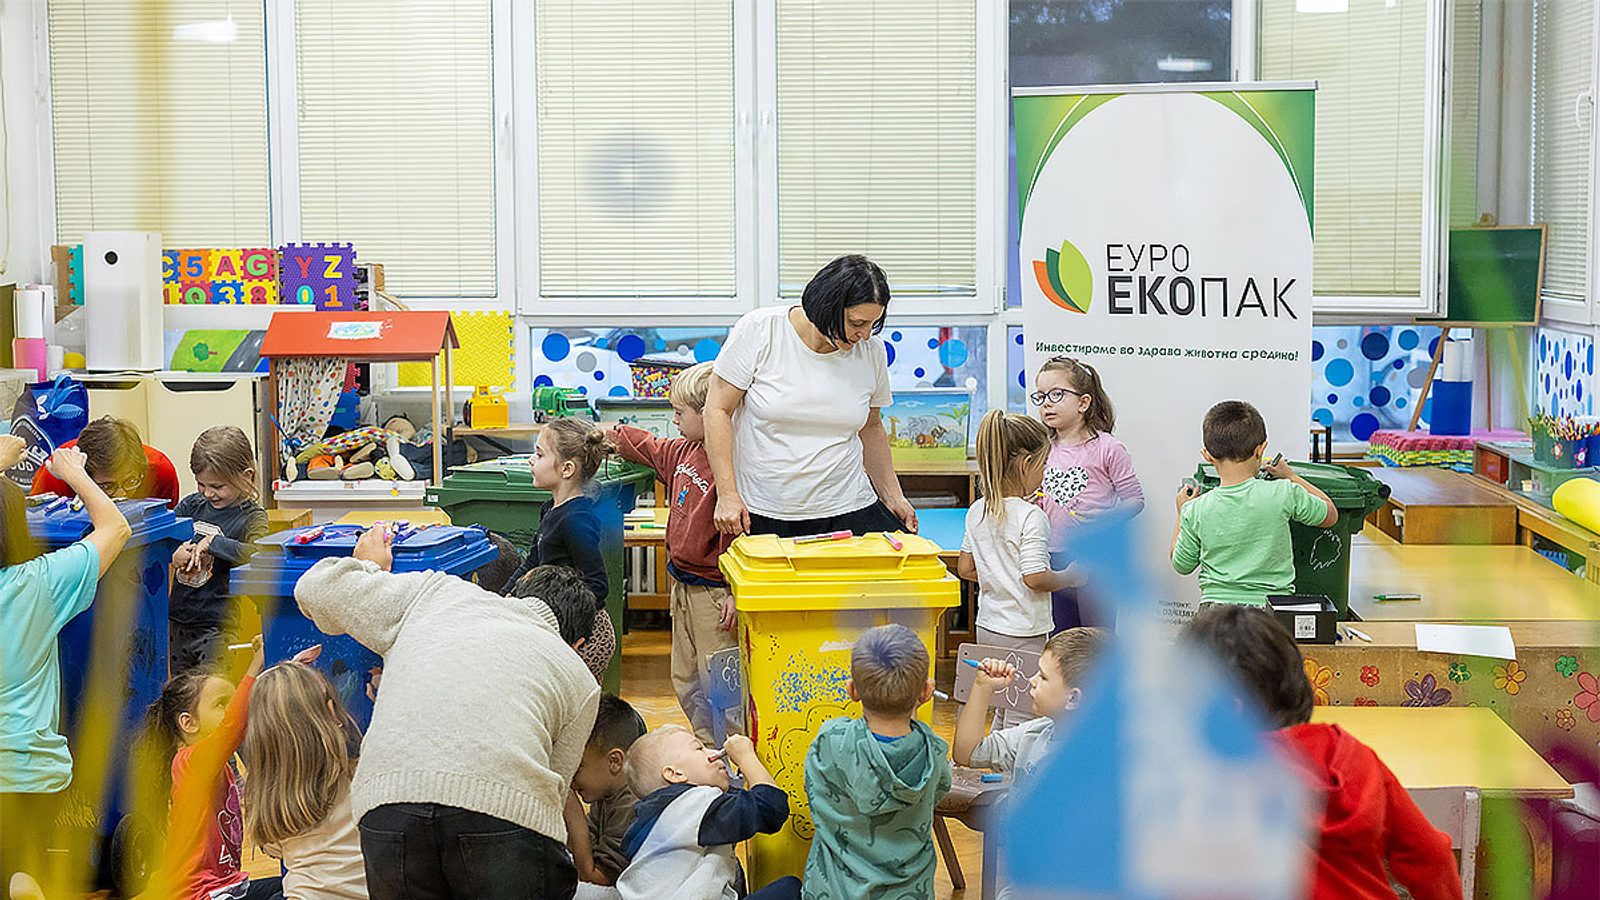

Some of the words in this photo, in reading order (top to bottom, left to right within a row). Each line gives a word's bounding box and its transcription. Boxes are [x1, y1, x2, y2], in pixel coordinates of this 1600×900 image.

[1106, 244, 1190, 272] ЕУРО
[1108, 275, 1298, 319] ЕКОПАК
[1035, 341, 1117, 356] Инвестираме
[1119, 346, 1135, 355] во
[1137, 346, 1182, 358] здрава
[1184, 348, 1238, 359] животна
[1241, 350, 1299, 361] средина!
